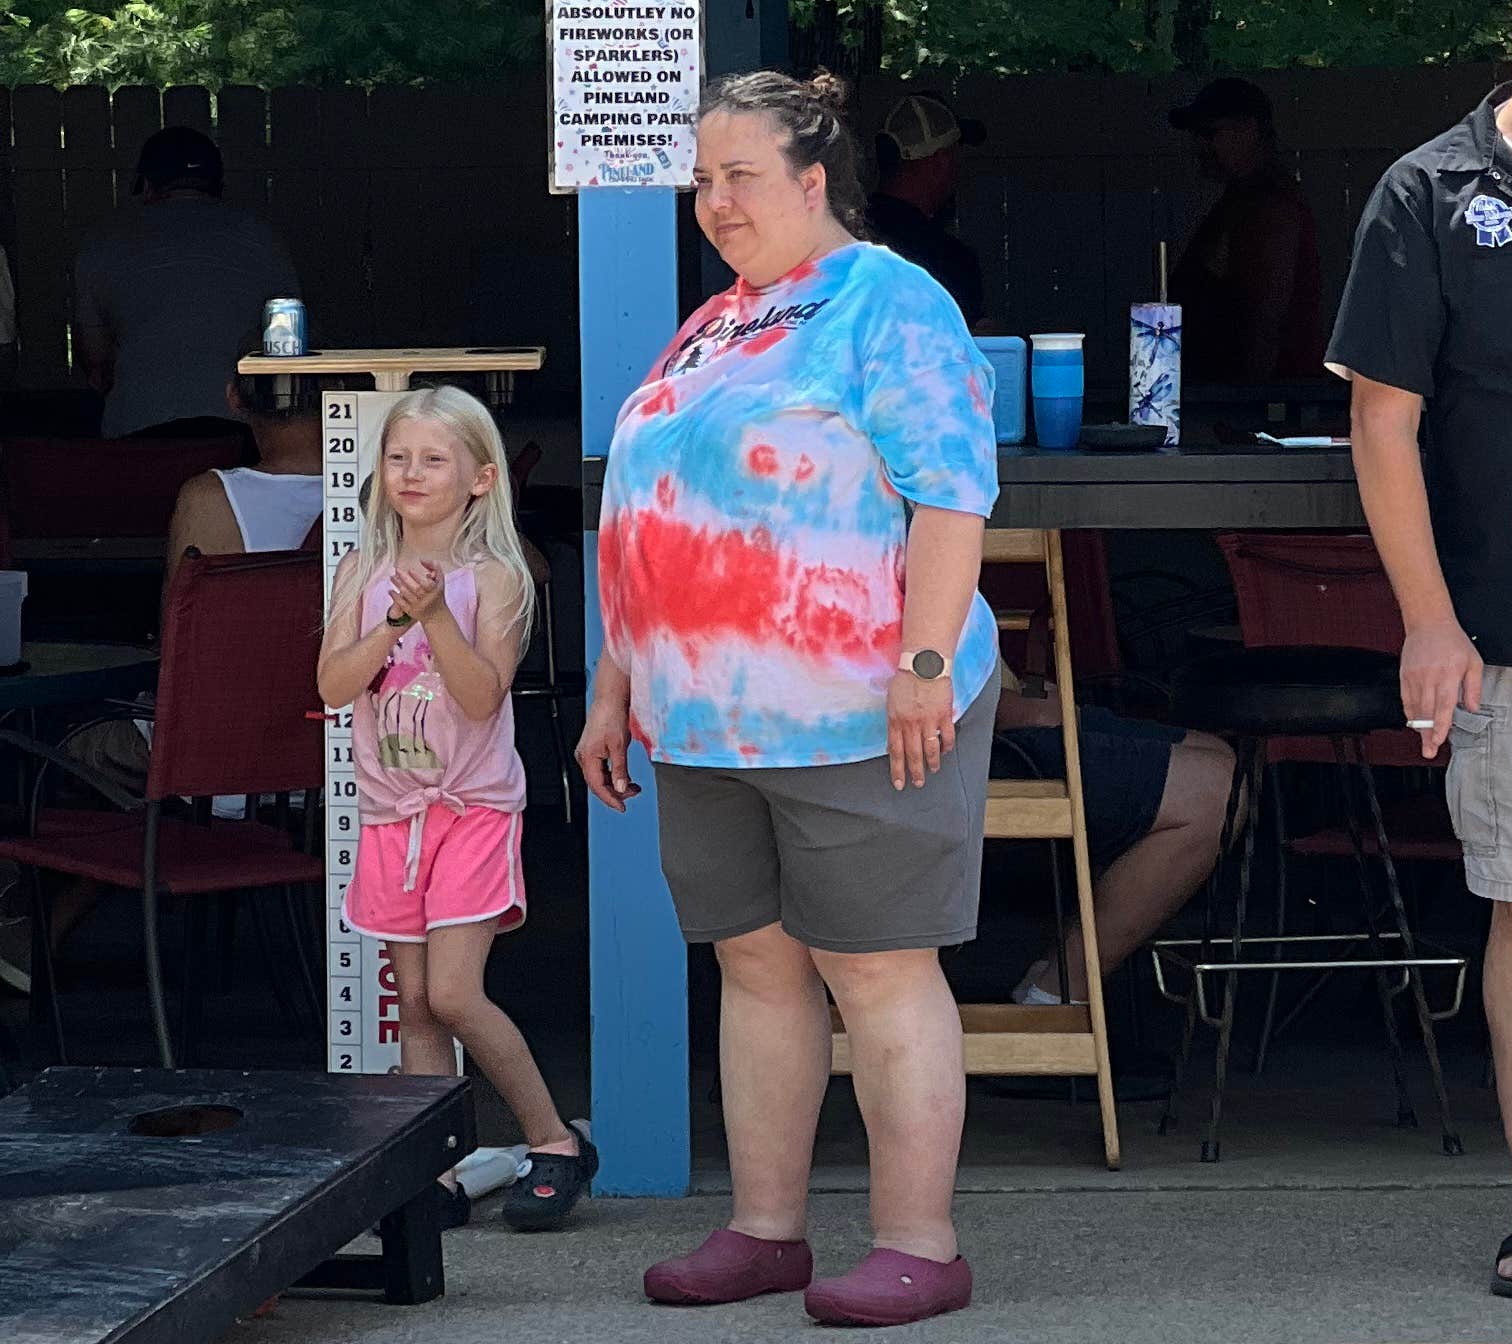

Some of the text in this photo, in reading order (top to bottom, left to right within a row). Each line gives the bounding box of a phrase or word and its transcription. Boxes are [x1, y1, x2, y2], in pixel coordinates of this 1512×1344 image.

[557, 7, 695, 19] ABSOLUTLEY NO
[559, 28, 694, 42] FIREWORKS (OR
[574, 49, 679, 63] SPARKLERS)
[571, 71, 681, 83] ALLOWED ON
[584, 92, 670, 104] PINELAND
[559, 113, 694, 125] CAMPING PARK
[581, 134, 673, 146] PREMISES!
[679, 298, 831, 352] Pineland
[329, 403, 352, 419] 21
[329, 438, 355, 453] 20
[331, 472, 355, 488] 19
[332, 507, 355, 522] 18
[332, 542, 355, 556] 17
[333, 713, 353, 728] 12
[333, 747, 354, 762] 11
[333, 782, 357, 797] 10
[338, 817, 350, 831] 9
[338, 850, 350, 866] 8
[339, 952, 351, 968] 5
[340, 986, 352, 1002] 4
[340, 1021, 352, 1036] 3
[340, 1055, 352, 1070] 2
